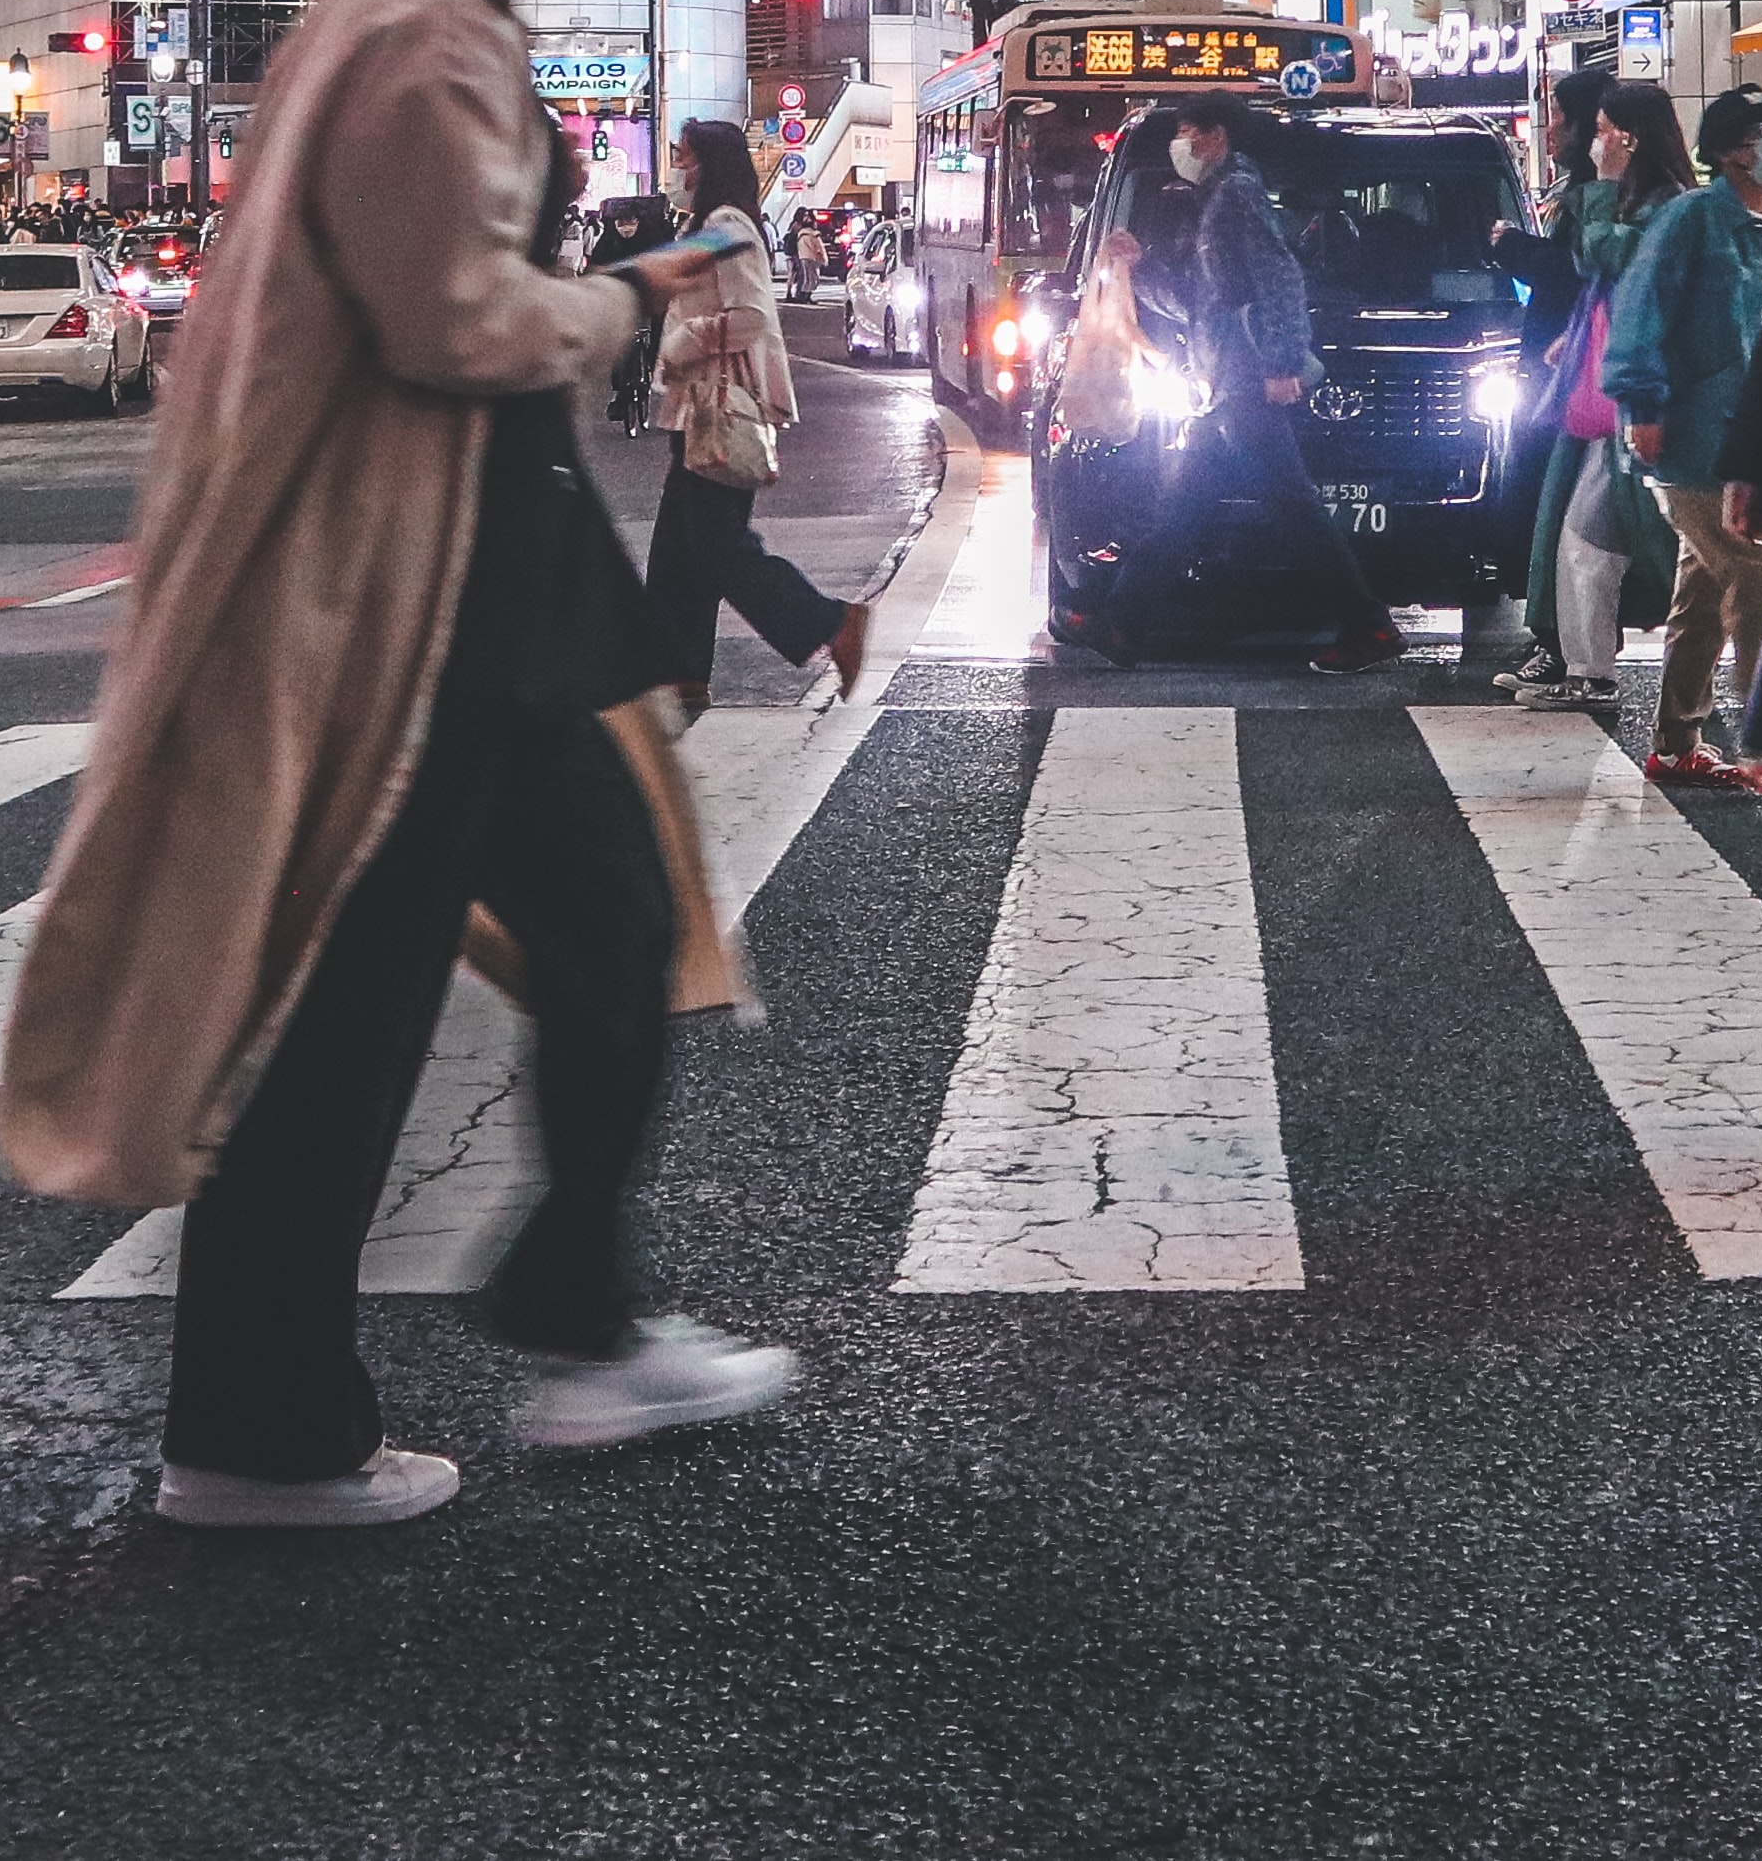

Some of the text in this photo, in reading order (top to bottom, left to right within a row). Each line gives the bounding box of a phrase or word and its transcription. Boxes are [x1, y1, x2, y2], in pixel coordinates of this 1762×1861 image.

[1141, 45, 1281, 70] 渋谷駅
[533, 79, 628, 92] AMPAIGN
[1339, 484, 1369, 500] 530
[1350, 502, 1387, 533] 70
